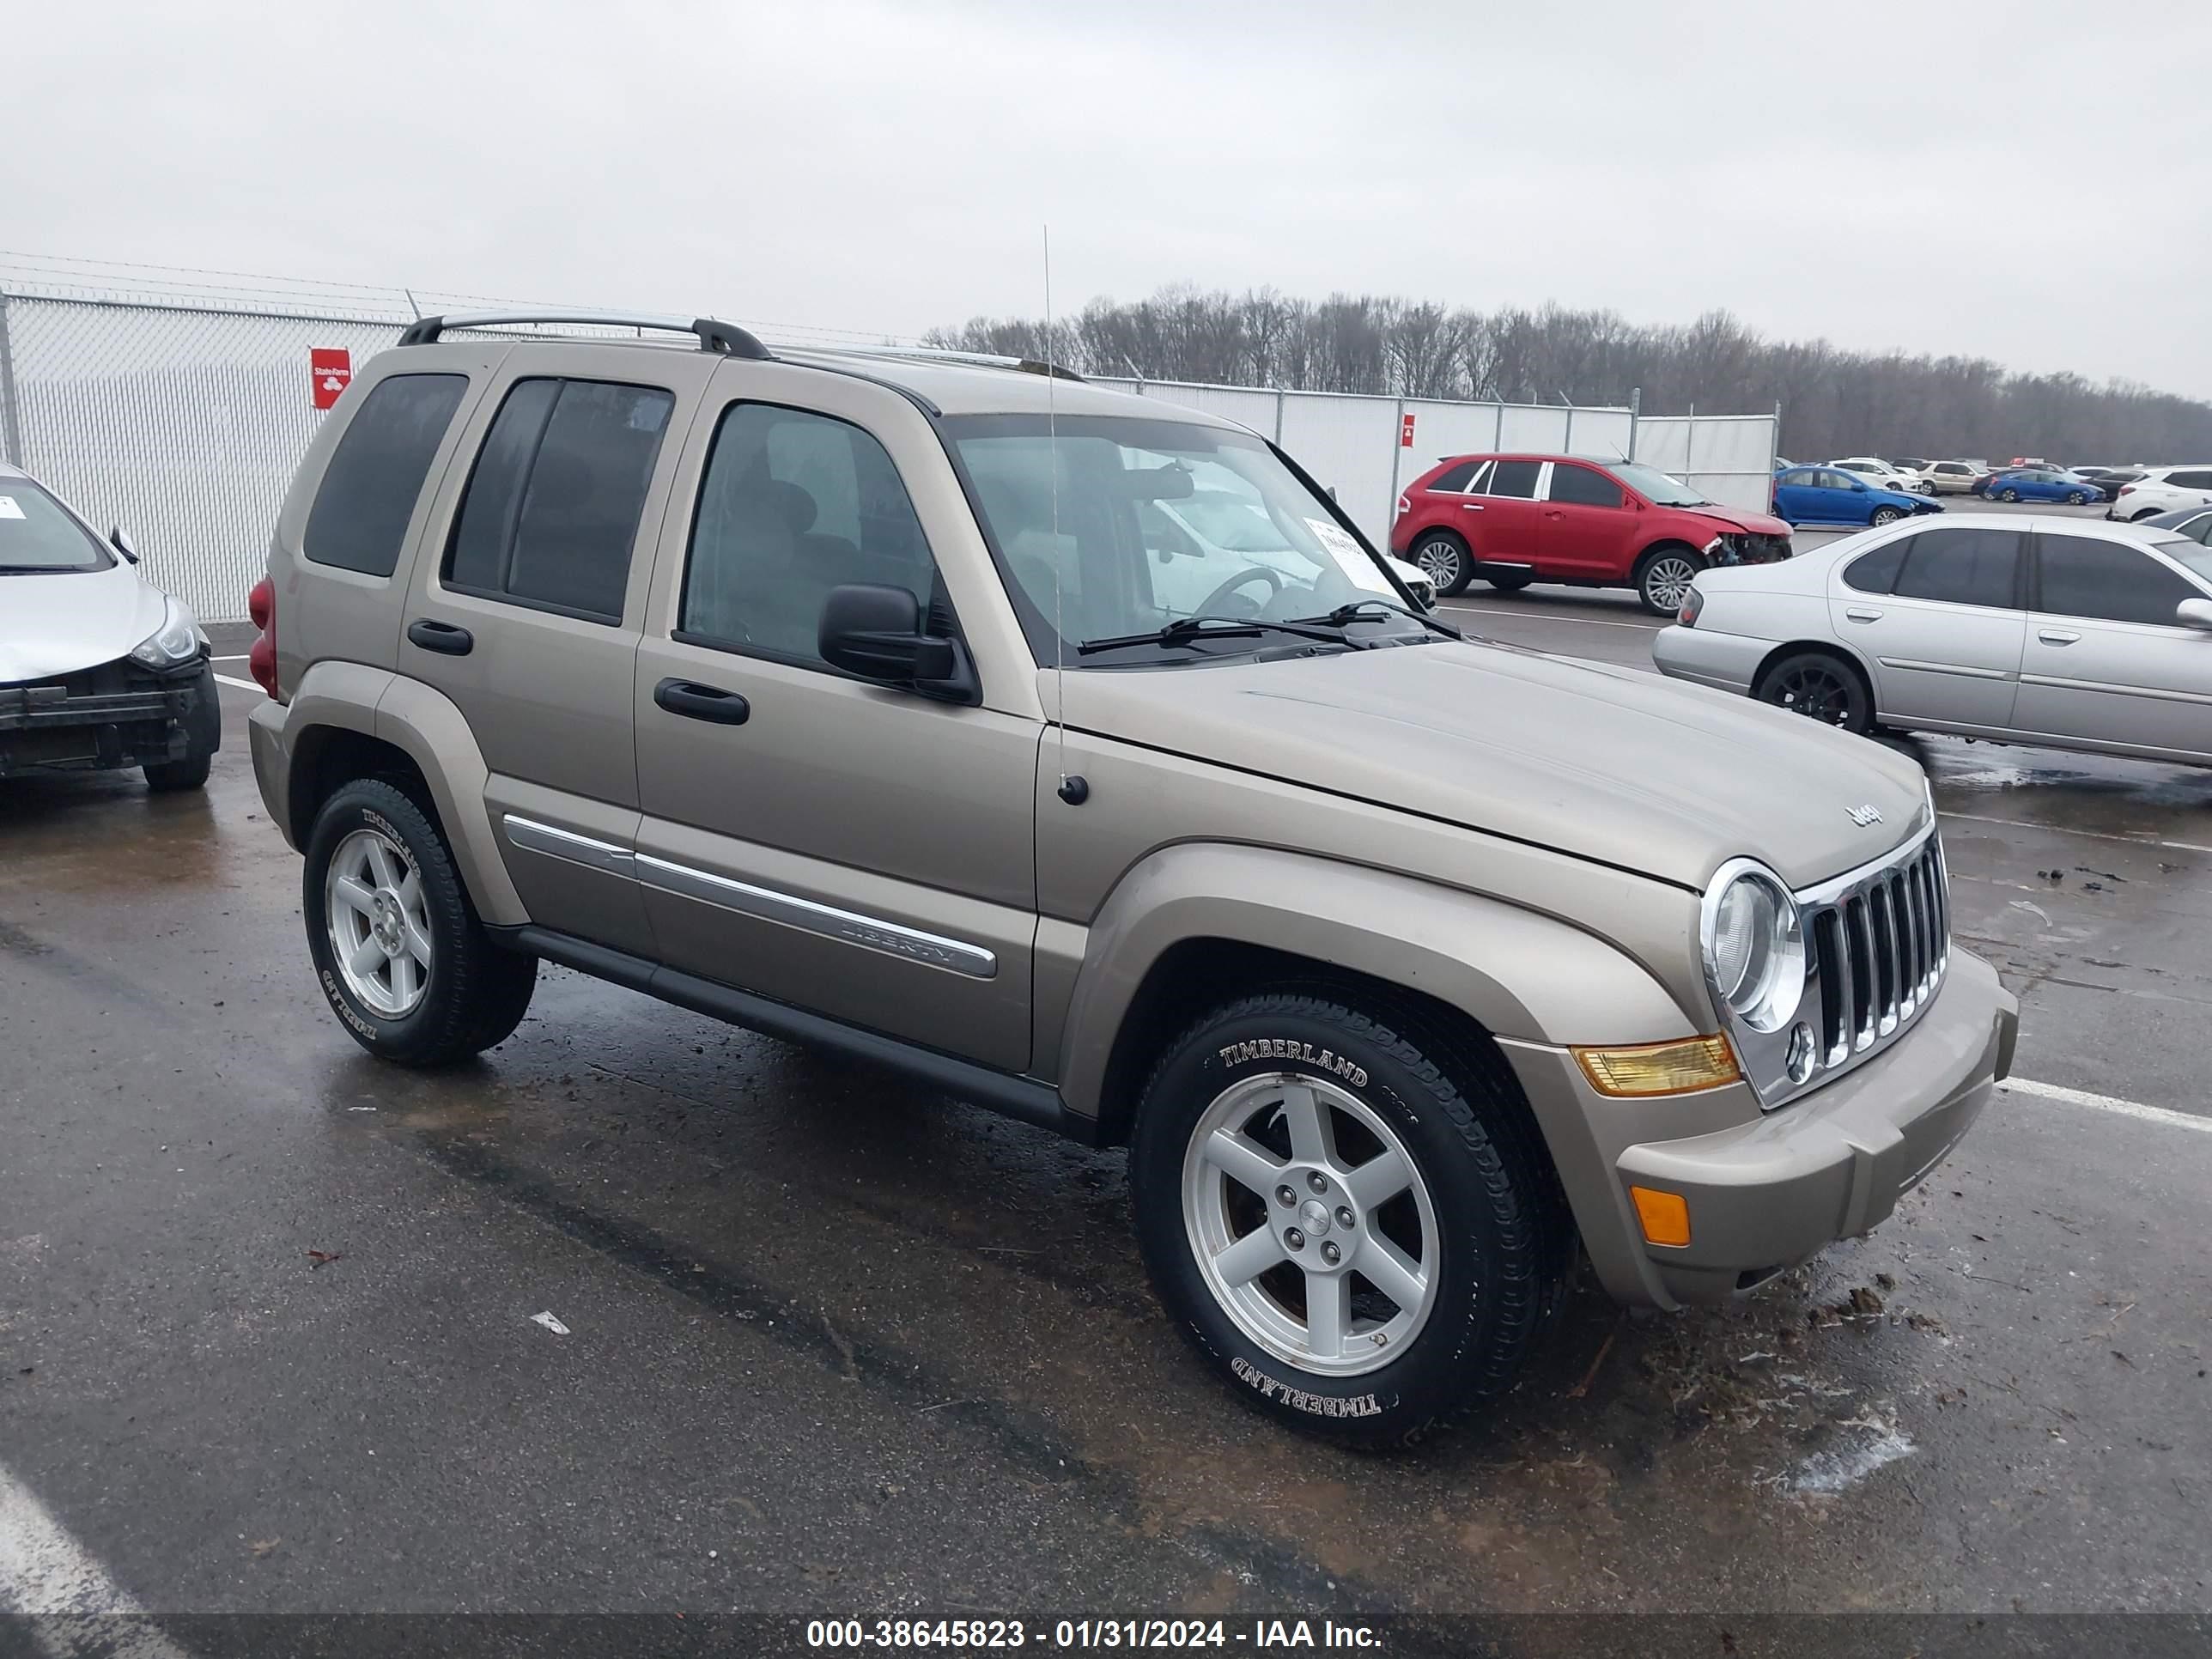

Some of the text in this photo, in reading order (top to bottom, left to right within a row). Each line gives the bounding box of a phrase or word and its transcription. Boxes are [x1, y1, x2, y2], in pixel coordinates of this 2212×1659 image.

[1844, 804, 1883, 827] Jeep
[1218, 1038, 1369, 1089] TIMBERLAND
[1231, 1356, 1382, 1419] TIMBERLAND
